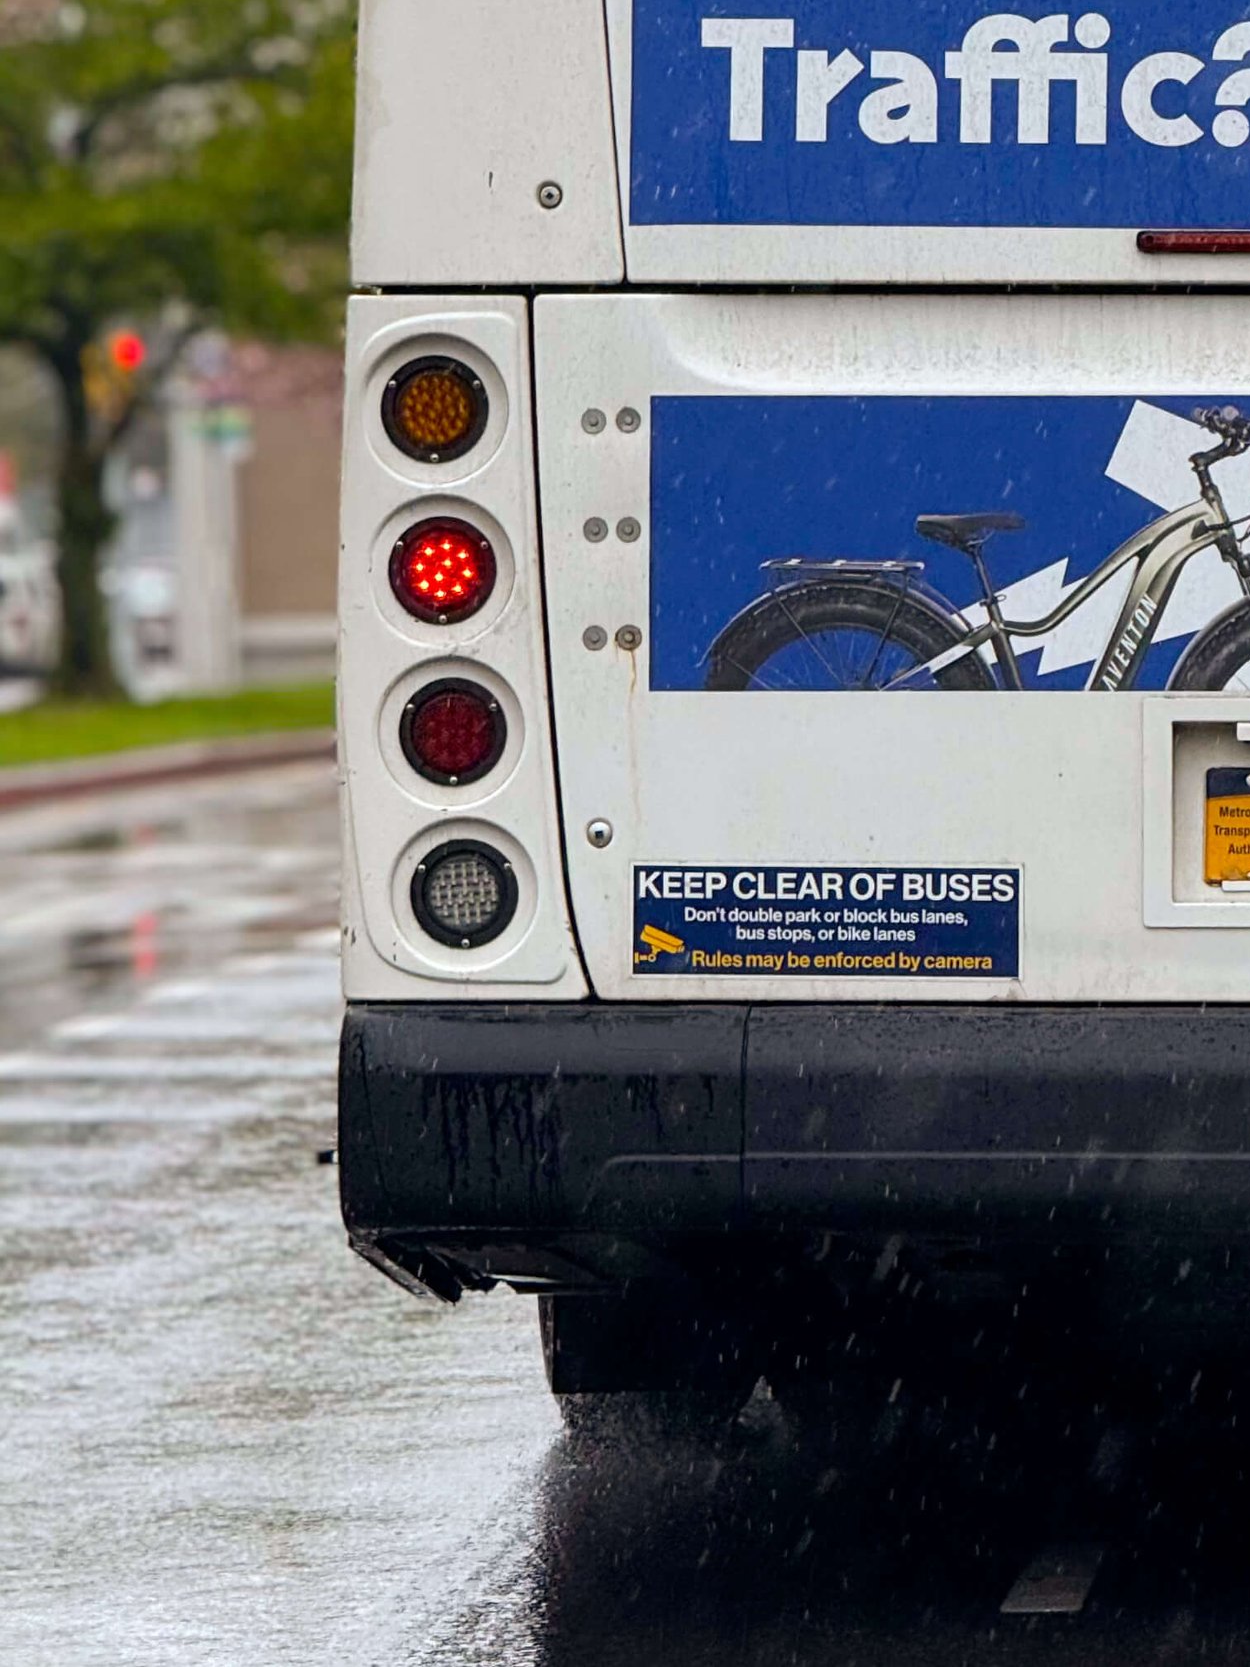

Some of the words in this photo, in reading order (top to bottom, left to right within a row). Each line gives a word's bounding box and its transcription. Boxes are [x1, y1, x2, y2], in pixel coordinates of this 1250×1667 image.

[638, 871, 726, 899] KEEP
[733, 871, 843, 901] CLEAR
[850, 873, 896, 901] OF
[902, 873, 1014, 902] BUSES
[684, 907, 727, 922] Don't
[728, 908, 783, 923] double
[786, 908, 820, 926] park
[824, 912, 840, 923] or
[843, 909, 887, 923] block
[890, 909, 919, 924] bus
[921, 909, 968, 926] lanes,
[736, 926, 764, 940] bus
[767, 927, 816, 943] stops,
[818, 930, 835, 941] or
[838, 927, 871, 941] bike
[874, 927, 915, 941] lanes
[692, 951, 744, 967] Rules
[746, 954, 783, 971] may
[787, 951, 810, 968] be
[813, 952, 895, 968] enforced
[898, 952, 920, 971] by
[924, 956, 992, 969] camera
